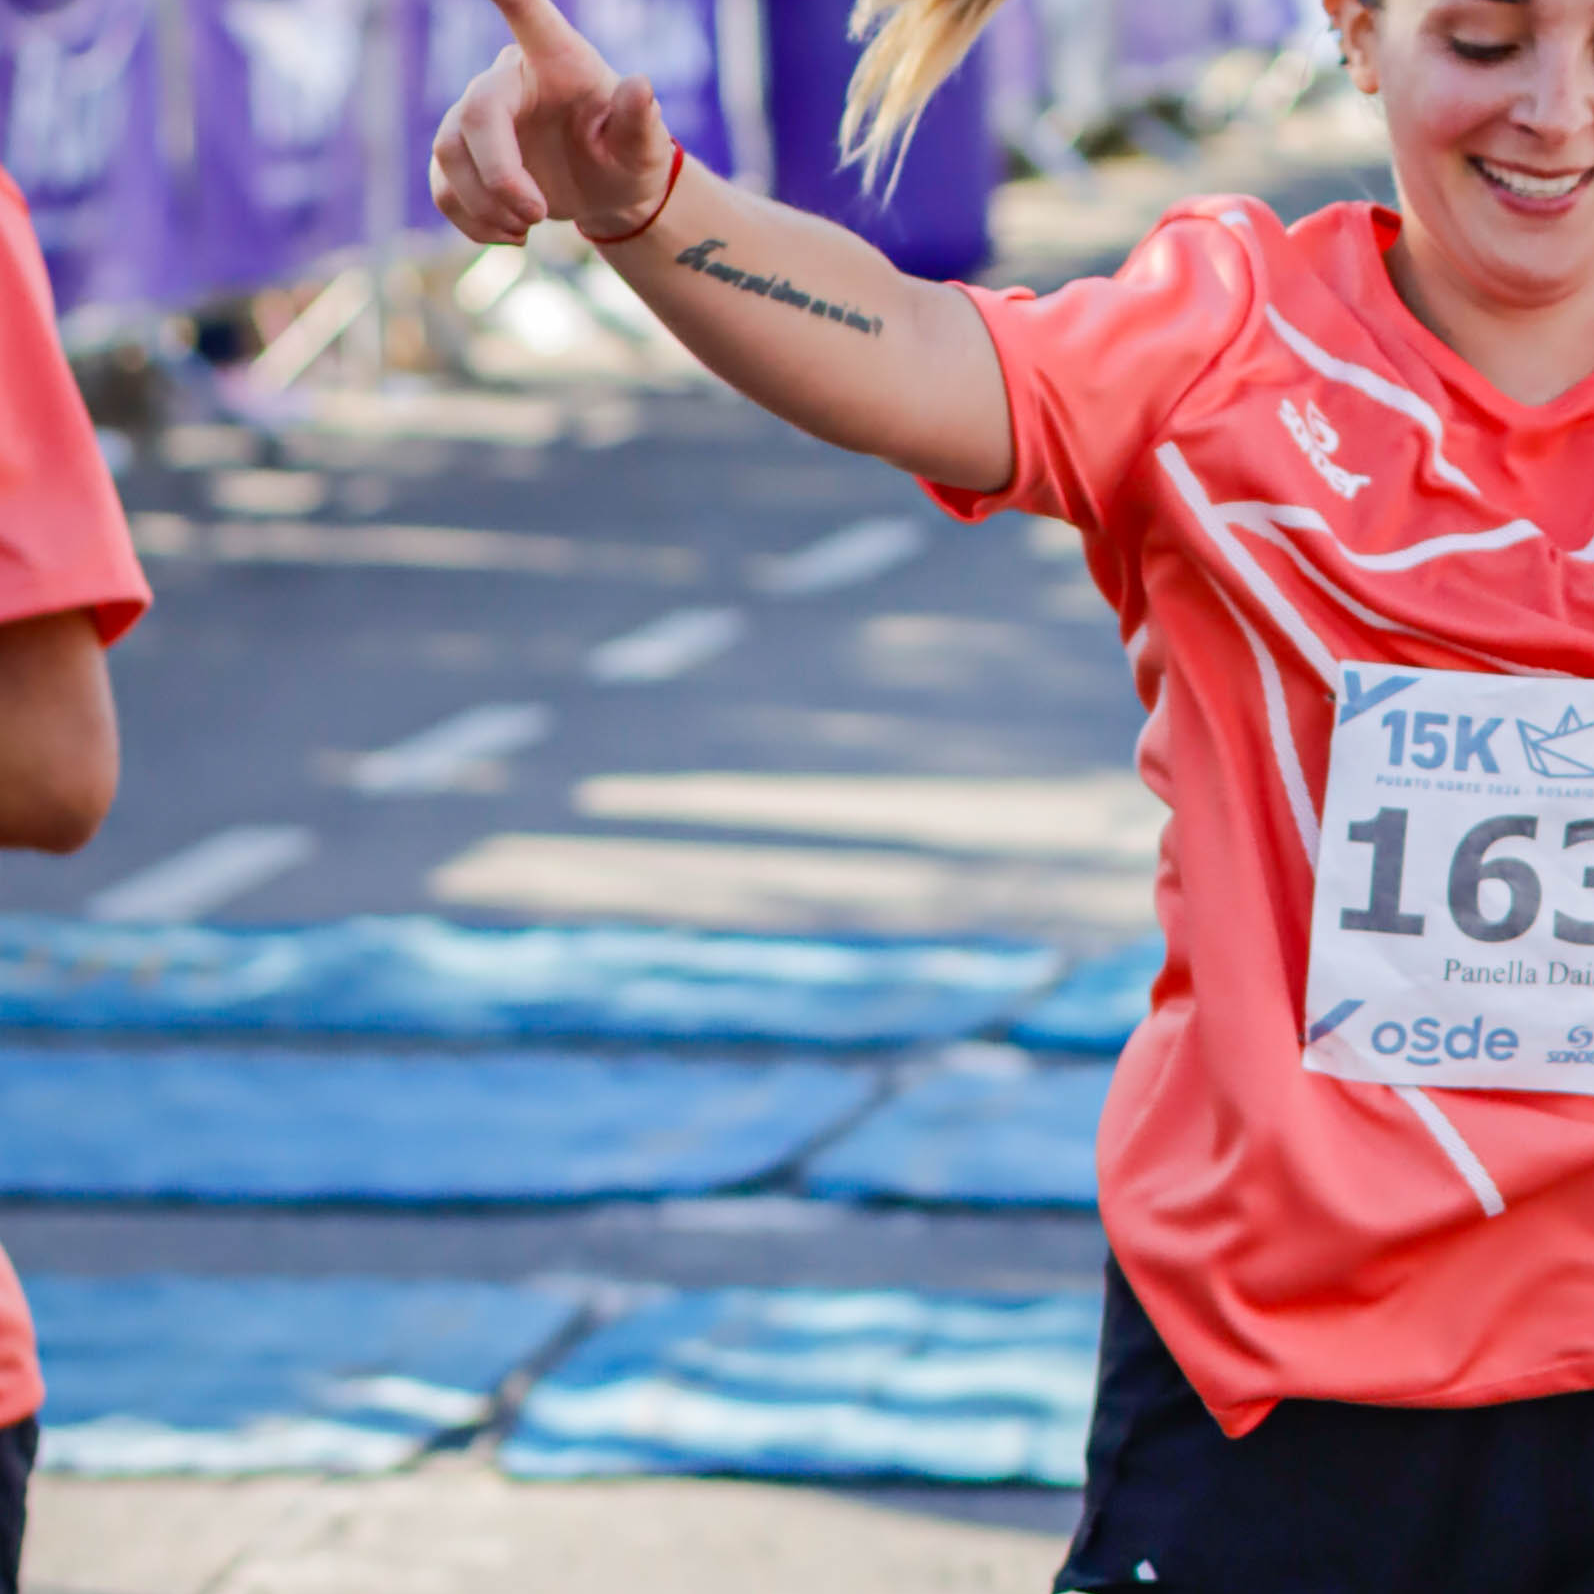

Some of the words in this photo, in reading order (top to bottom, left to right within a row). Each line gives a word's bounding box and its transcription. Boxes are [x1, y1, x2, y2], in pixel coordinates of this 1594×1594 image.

[1380, 708, 1505, 774] 15K
[1443, 958, 1537, 985] Panella
[1371, 1015, 1520, 1065] osde
